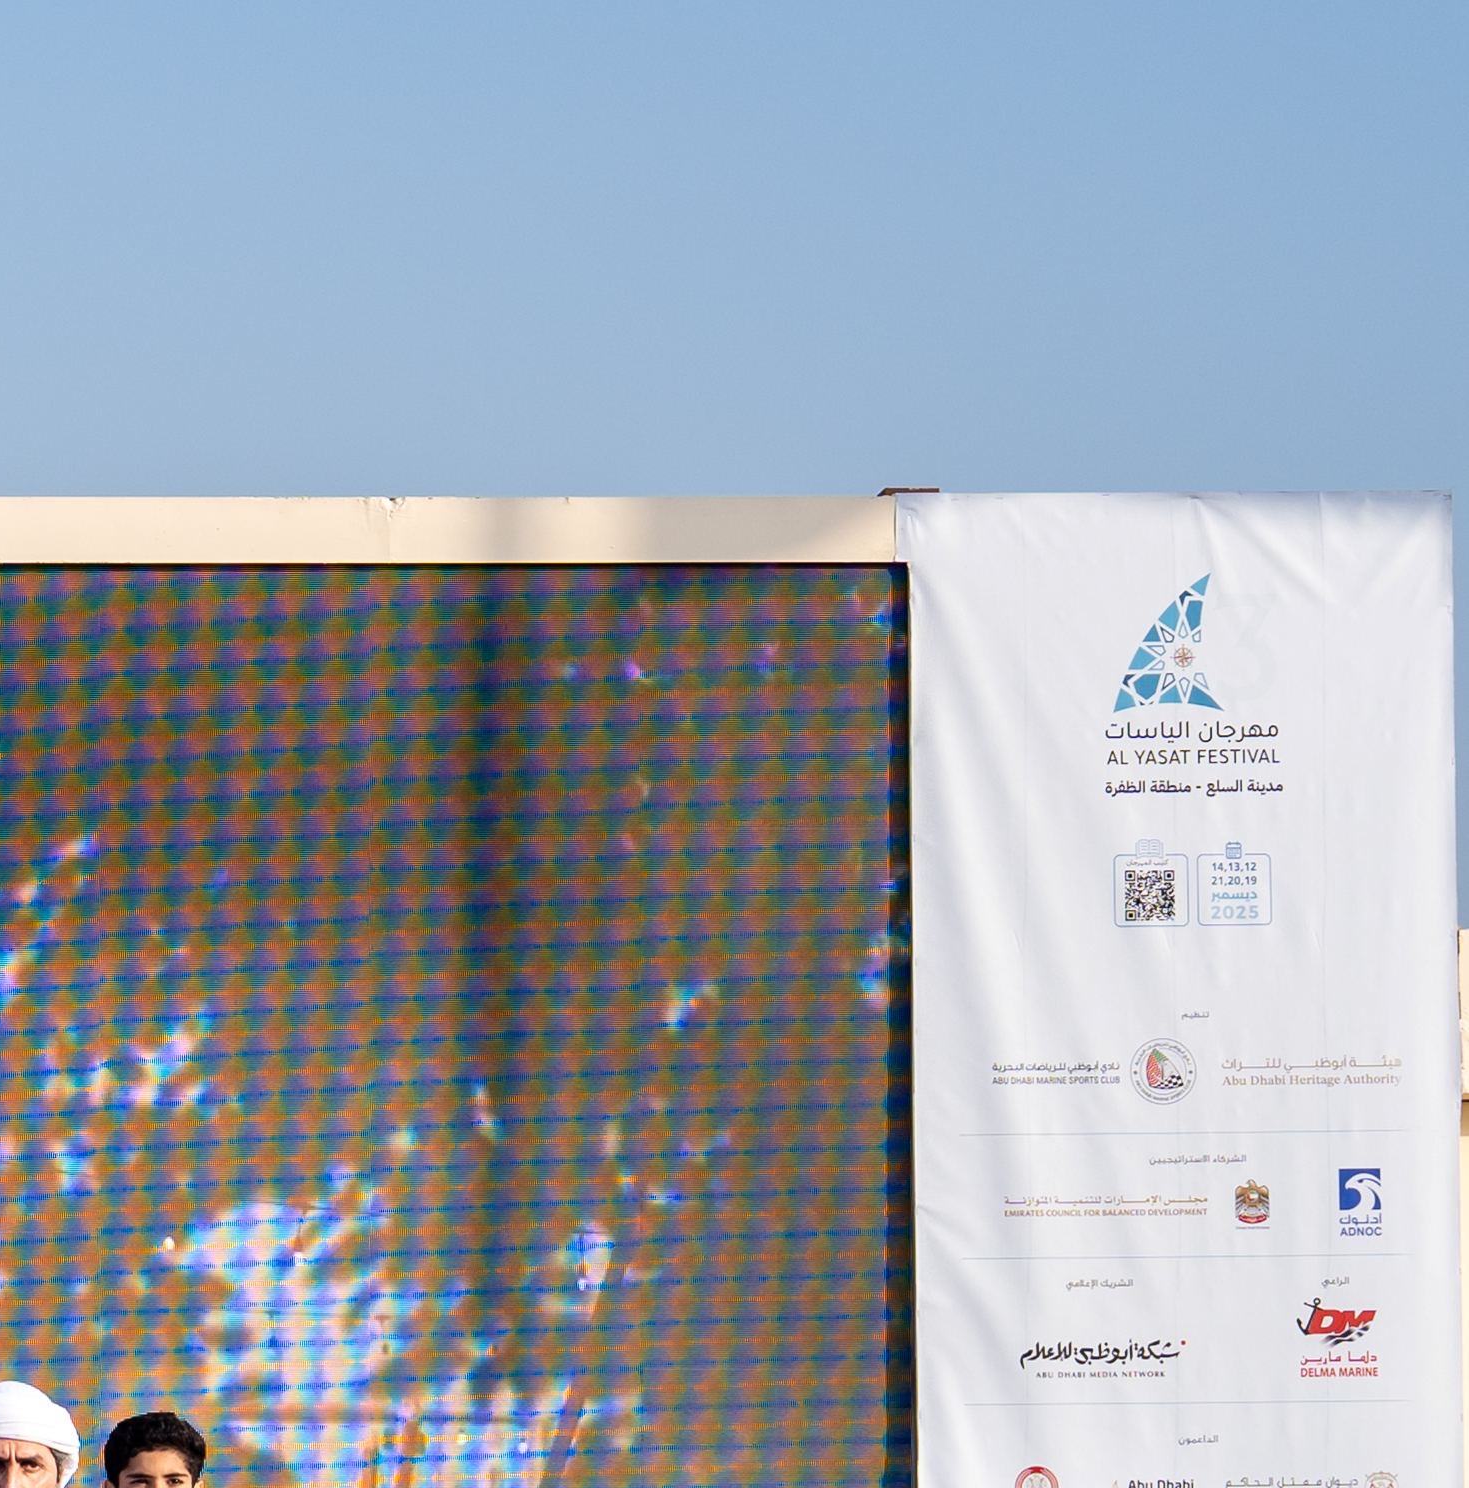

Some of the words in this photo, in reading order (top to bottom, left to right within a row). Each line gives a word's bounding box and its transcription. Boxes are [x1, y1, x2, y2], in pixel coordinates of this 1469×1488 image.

[1105, 721, 1190, 744] الياسات
[1198, 720, 1280, 743] مهرجان
[1106, 750, 1129, 765] AL
[1134, 749, 1192, 764] YASAT
[1197, 748, 1281, 764] FESTIVAL
[1104, 780, 1146, 797] الظفرة
[1149, 780, 1192, 793] منطقة
[1205, 779, 1243, 797] السلع
[1247, 780, 1284, 795] مدينة
[1211, 905, 1259, 920] 2025
[992, 1077, 1010, 1085] ABU
[1010, 1077, 1035, 1085] DHABI
[1036, 1077, 1067, 1085] MARINE
[1068, 1076, 1099, 1085] SPORTS
[1100, 1076, 1121, 1084] CLUB
[1222, 1076, 1247, 1086] Abu
[1250, 1075, 1286, 1086] Dhabi
[1289, 1074, 1341, 1087] Heritage
[1344, 1074, 1403, 1087] Authority
[1004, 1209, 1045, 1217] EMIRATES
[1045, 1209, 1082, 1217] COUNCIL
[1083, 1209, 1101, 1217] FOR
[1101, 1208, 1147, 1217] BALANCED
[1147, 1208, 1208, 1216] DEVELOPMENT
[1339, 1212, 1382, 1225] أدنوك
[1339, 1226, 1383, 1237] ADNOC
[1300, 1367, 1337, 1378] DELMA
[1338, 1367, 1379, 1377] MARINE
